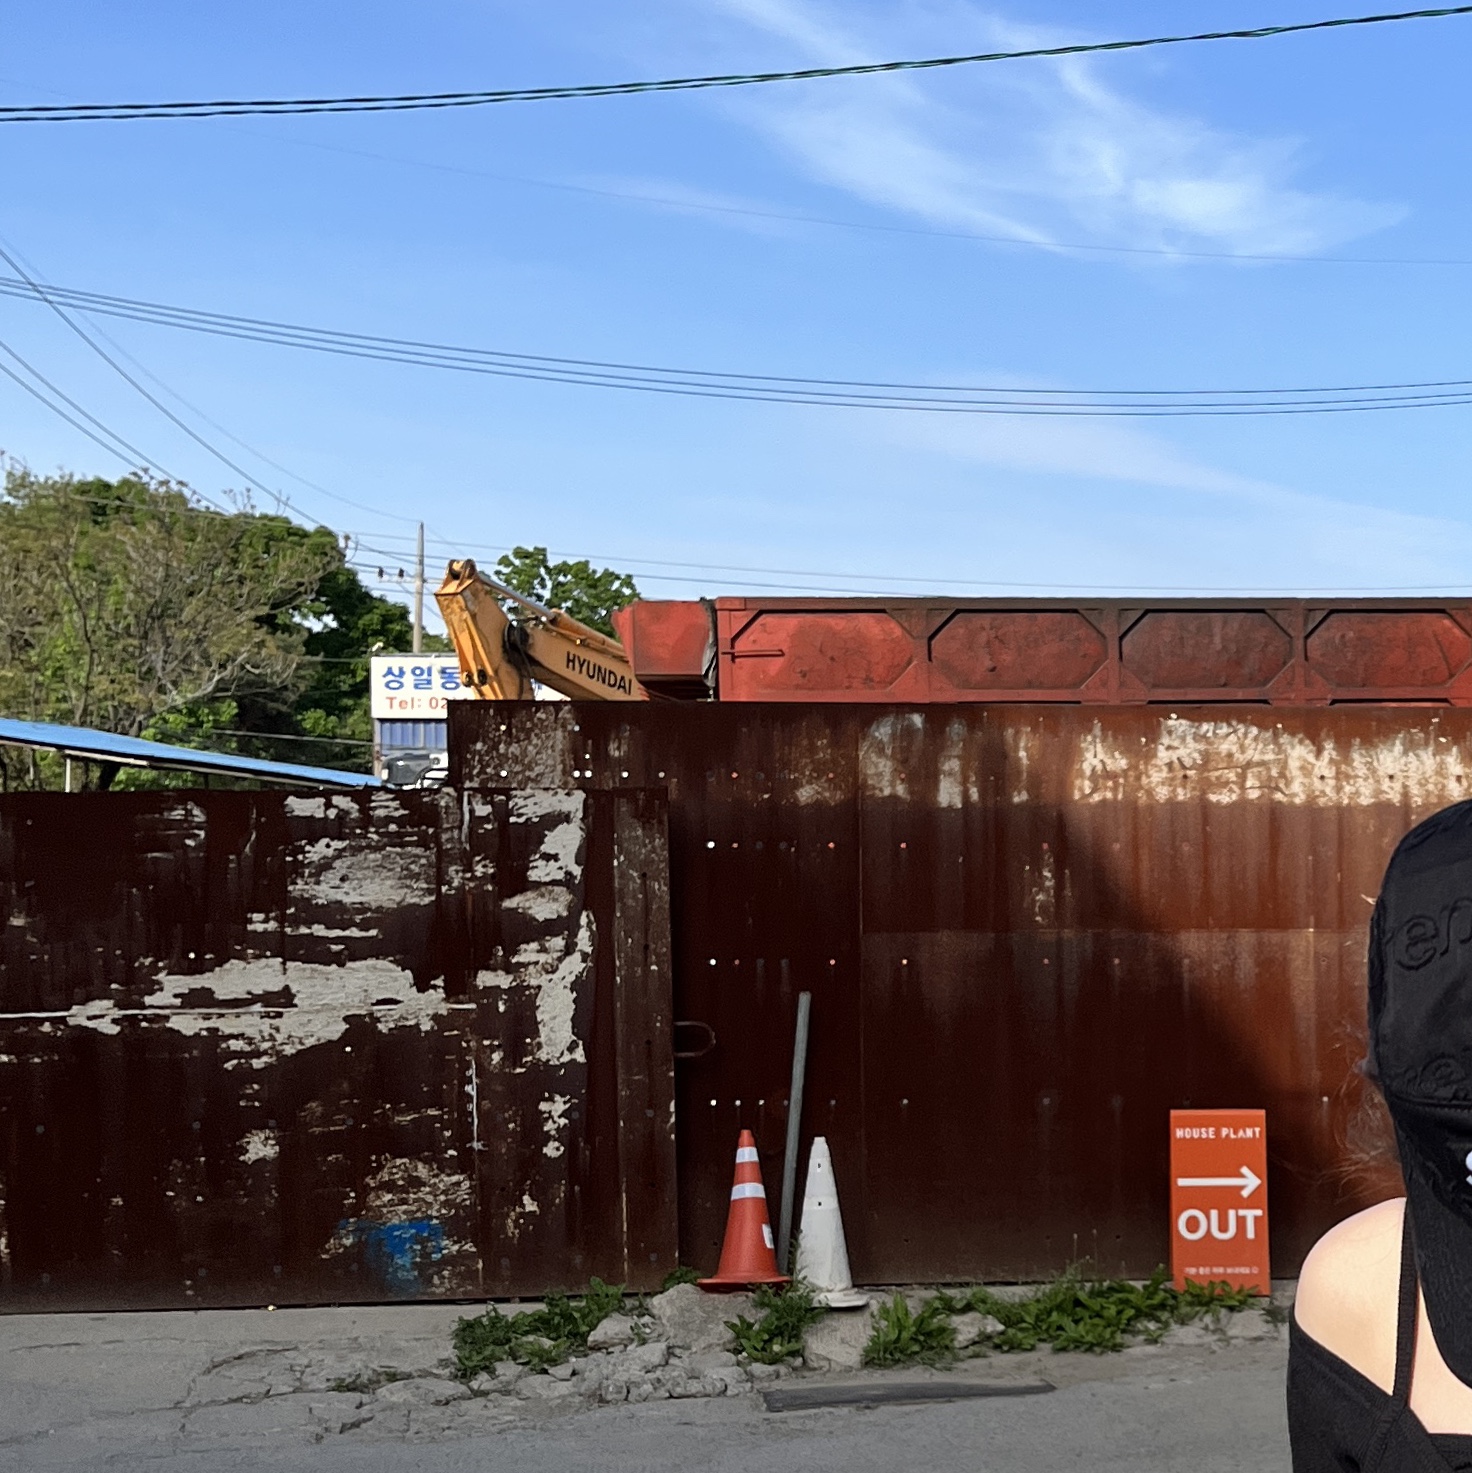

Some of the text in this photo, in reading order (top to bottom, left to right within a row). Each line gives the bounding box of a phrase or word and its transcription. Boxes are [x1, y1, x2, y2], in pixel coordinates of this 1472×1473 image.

[565, 651, 632, 696] HYUNDAI
[386, 697, 422, 710] Tel:
[1175, 1127, 1261, 1139] HOUSE PLANT
[1177, 1208, 1264, 1241] OUT
